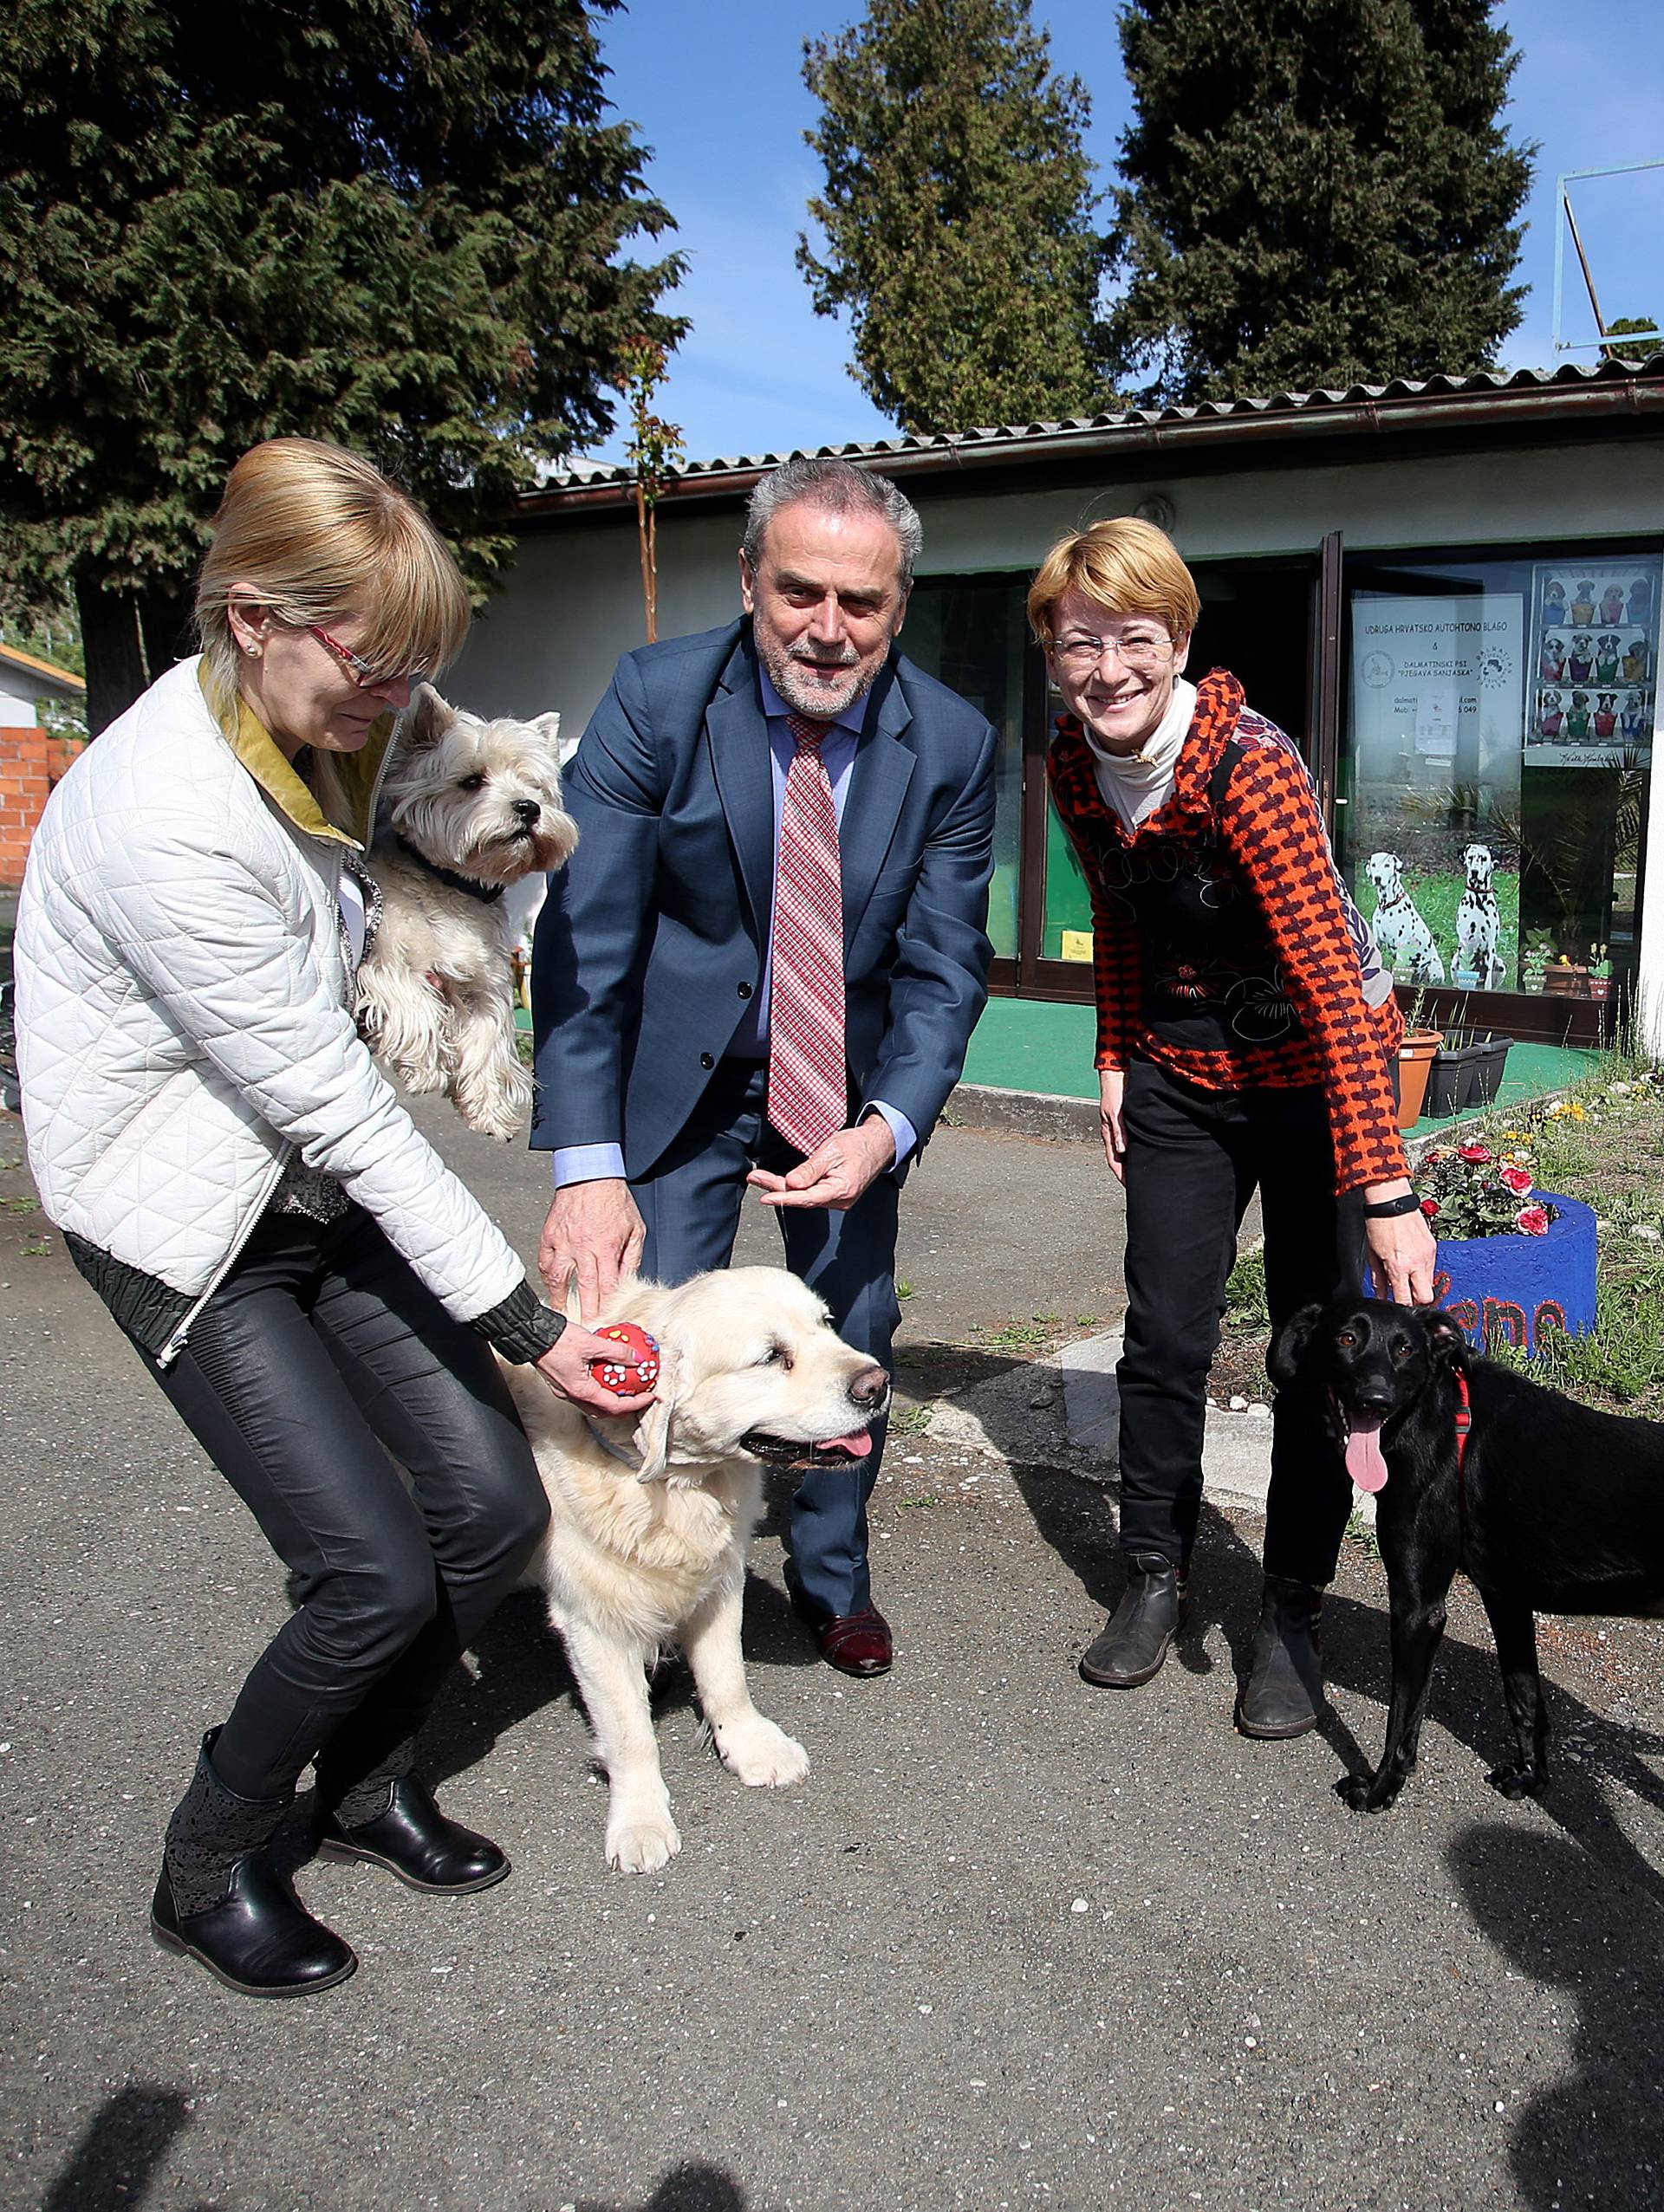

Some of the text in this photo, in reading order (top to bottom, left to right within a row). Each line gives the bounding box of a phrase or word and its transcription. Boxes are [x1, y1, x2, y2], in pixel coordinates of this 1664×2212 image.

[1365, 622, 1507, 634] UDRUGA HRVATSKO AUTOHTONO BLAGO
[1454, 659, 1467, 668] PSI
